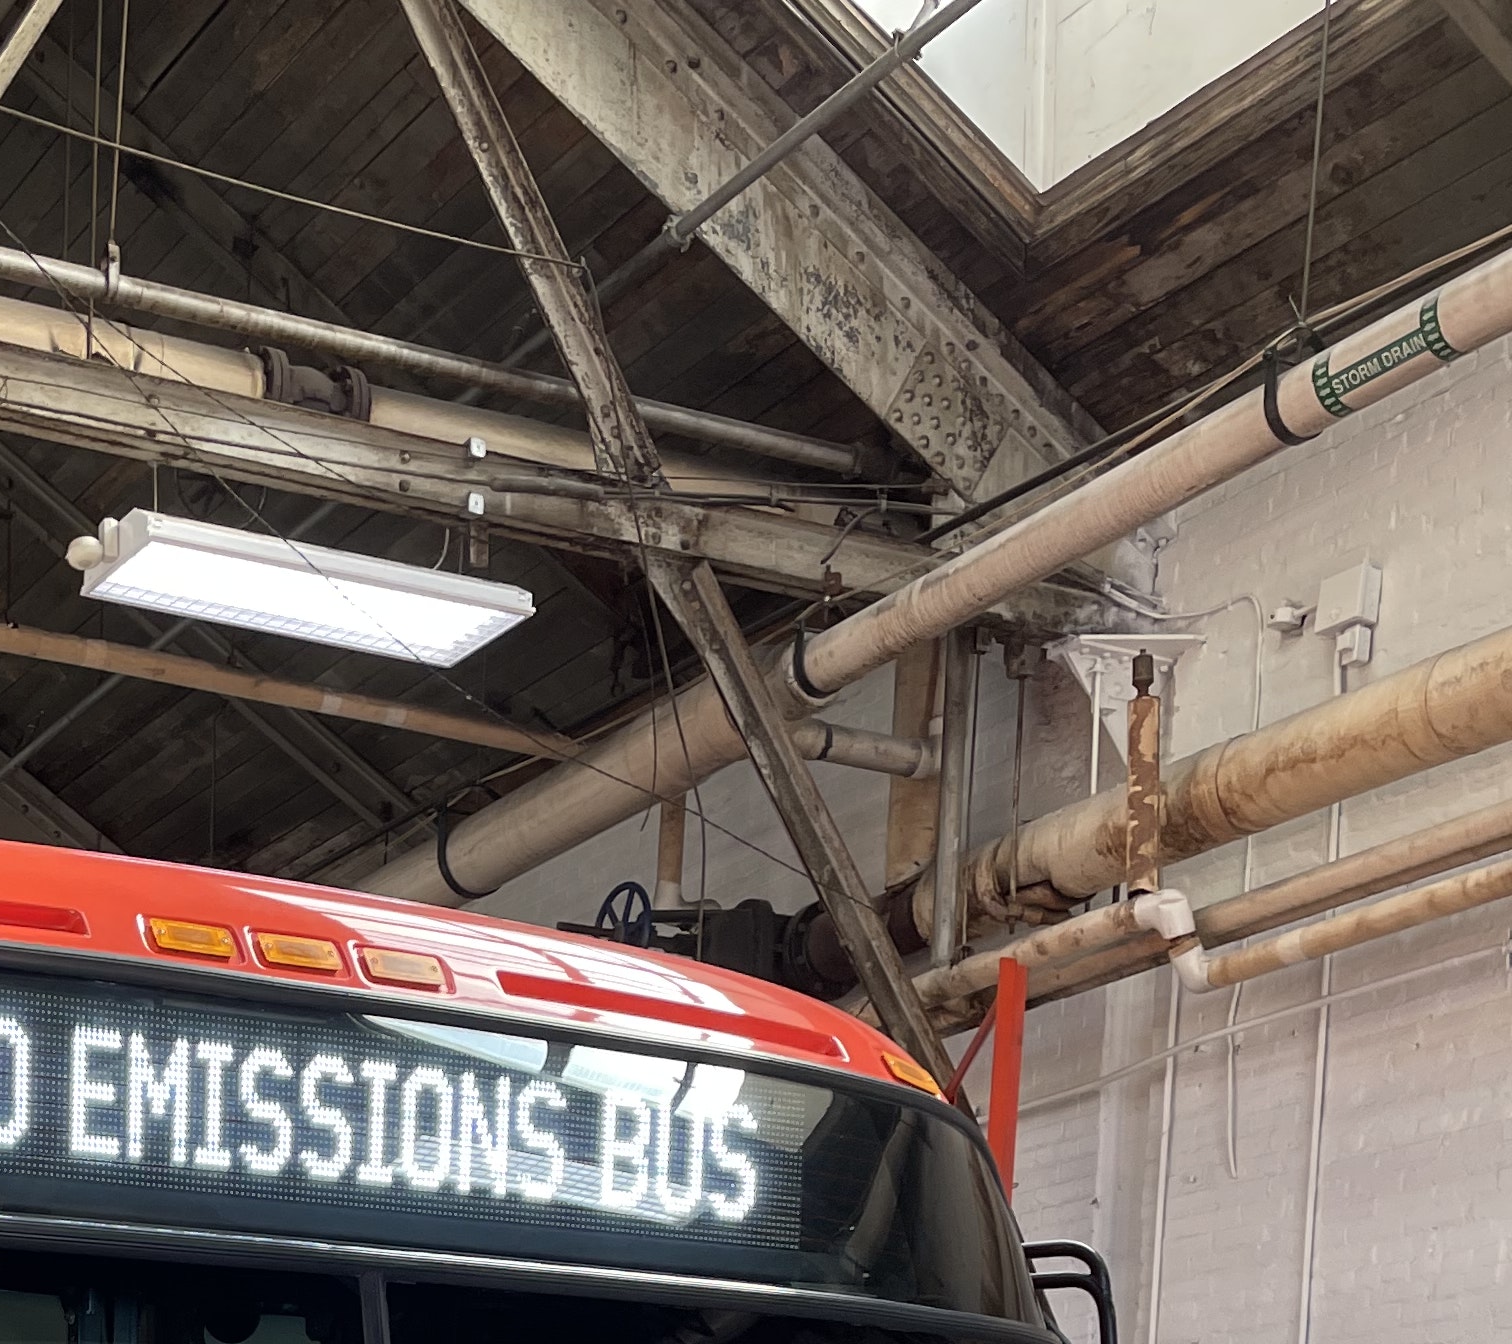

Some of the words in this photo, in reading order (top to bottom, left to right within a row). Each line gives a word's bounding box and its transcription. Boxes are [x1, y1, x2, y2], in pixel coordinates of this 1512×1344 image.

[1332, 358, 1382, 394] STORM
[1381, 333, 1428, 367] DRAIN
[70, 1024, 567, 1200] EMISSIONS
[600, 1088, 759, 1223] BUS
